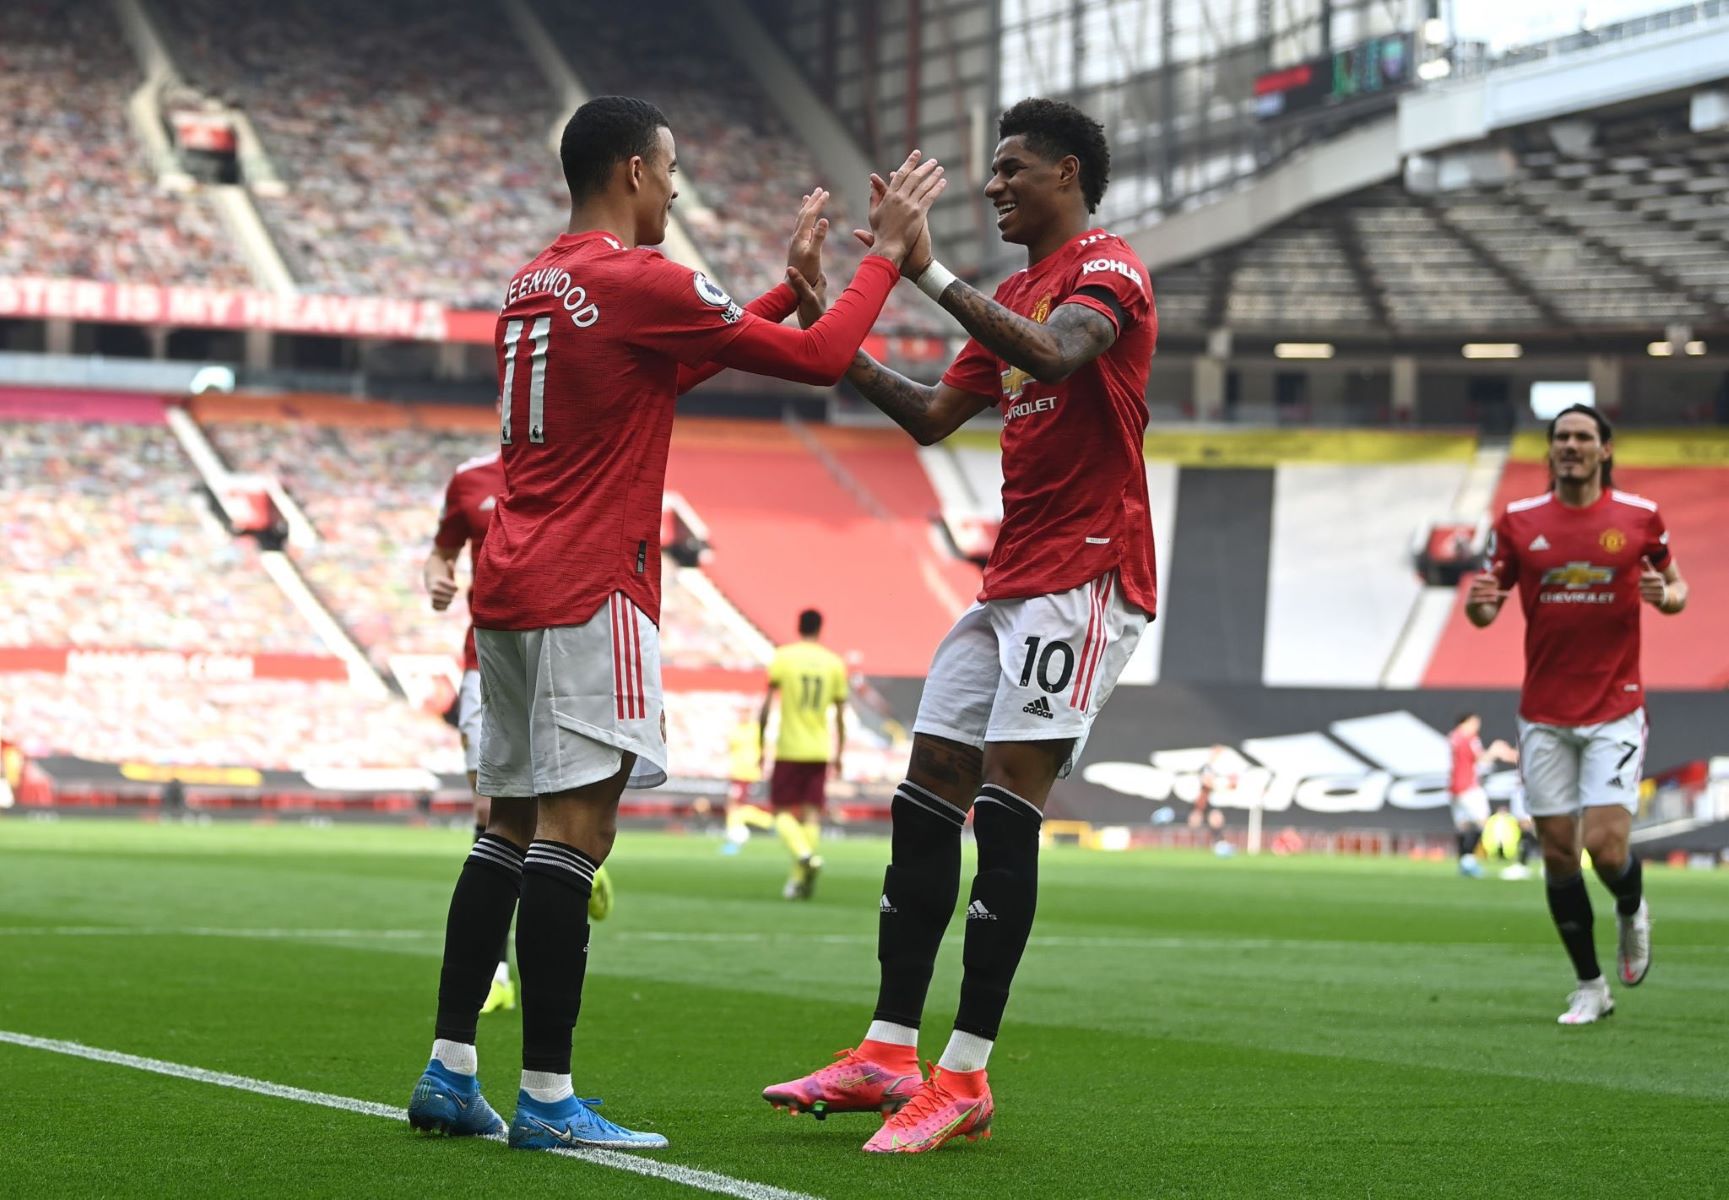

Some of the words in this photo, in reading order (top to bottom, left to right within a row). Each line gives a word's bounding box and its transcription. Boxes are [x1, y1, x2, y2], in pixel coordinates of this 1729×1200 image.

[1082, 258, 1143, 286] KOHLE
[169, 287, 233, 321] MY
[499, 267, 599, 329] EENWOOD
[501, 317, 551, 444] 11
[1540, 591, 1616, 604] CHEVROLET
[1019, 635, 1075, 694] 10
[799, 674, 823, 712] 11
[1022, 706, 1054, 720] adidas
[1616, 740, 1638, 770] 7
